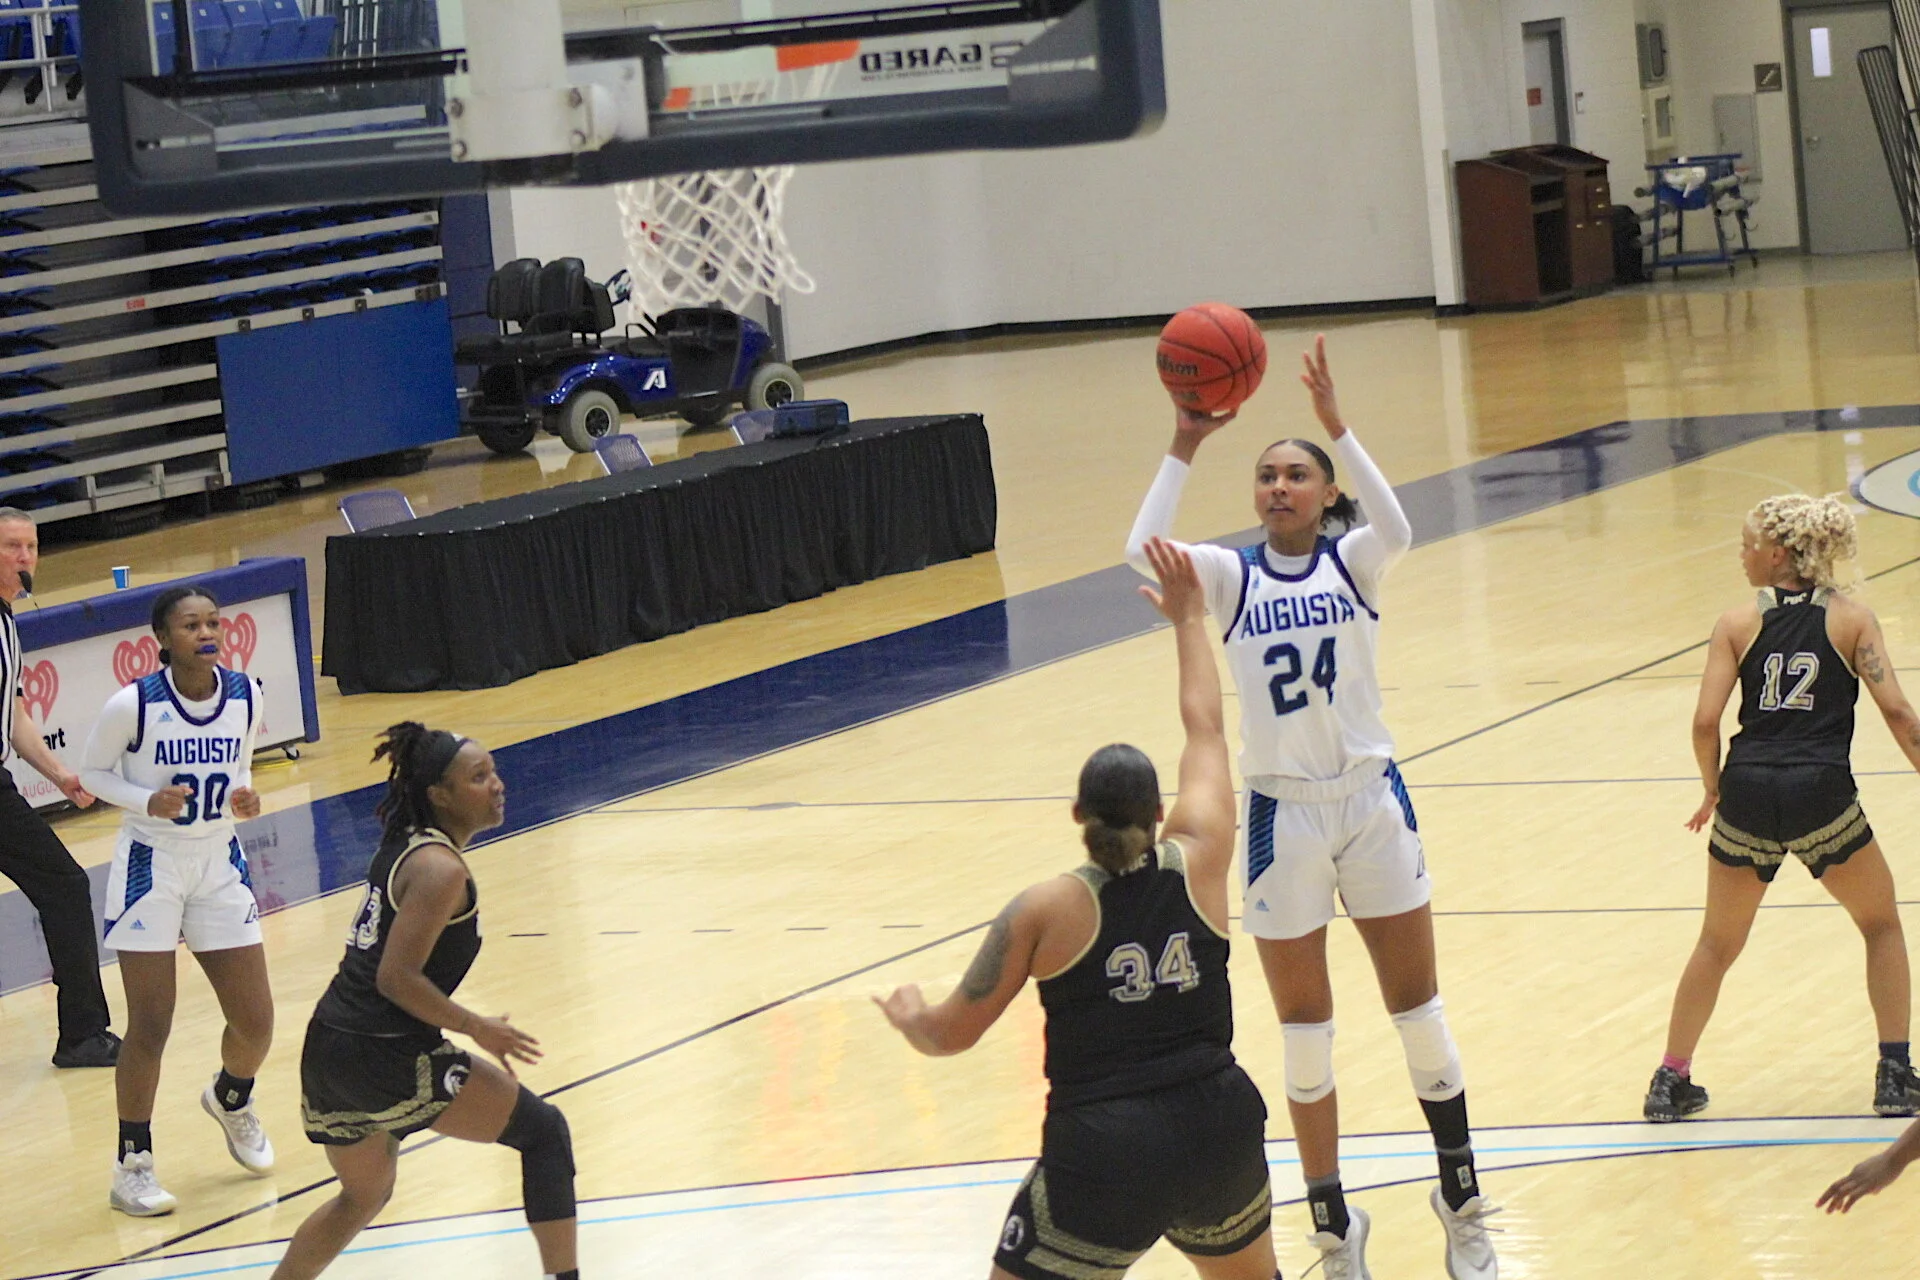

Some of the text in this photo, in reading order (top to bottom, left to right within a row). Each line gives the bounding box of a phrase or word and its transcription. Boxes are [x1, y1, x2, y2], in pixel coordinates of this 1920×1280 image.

[642, 366, 667, 391] A
[1240, 591, 1354, 640] AUGUSTA
[1263, 635, 1337, 716] 24
[1759, 652, 1820, 711] 12
[154, 737, 241, 765] AUGUSTA
[170, 773, 230, 825] 30
[1105, 931, 1200, 1003] 34
